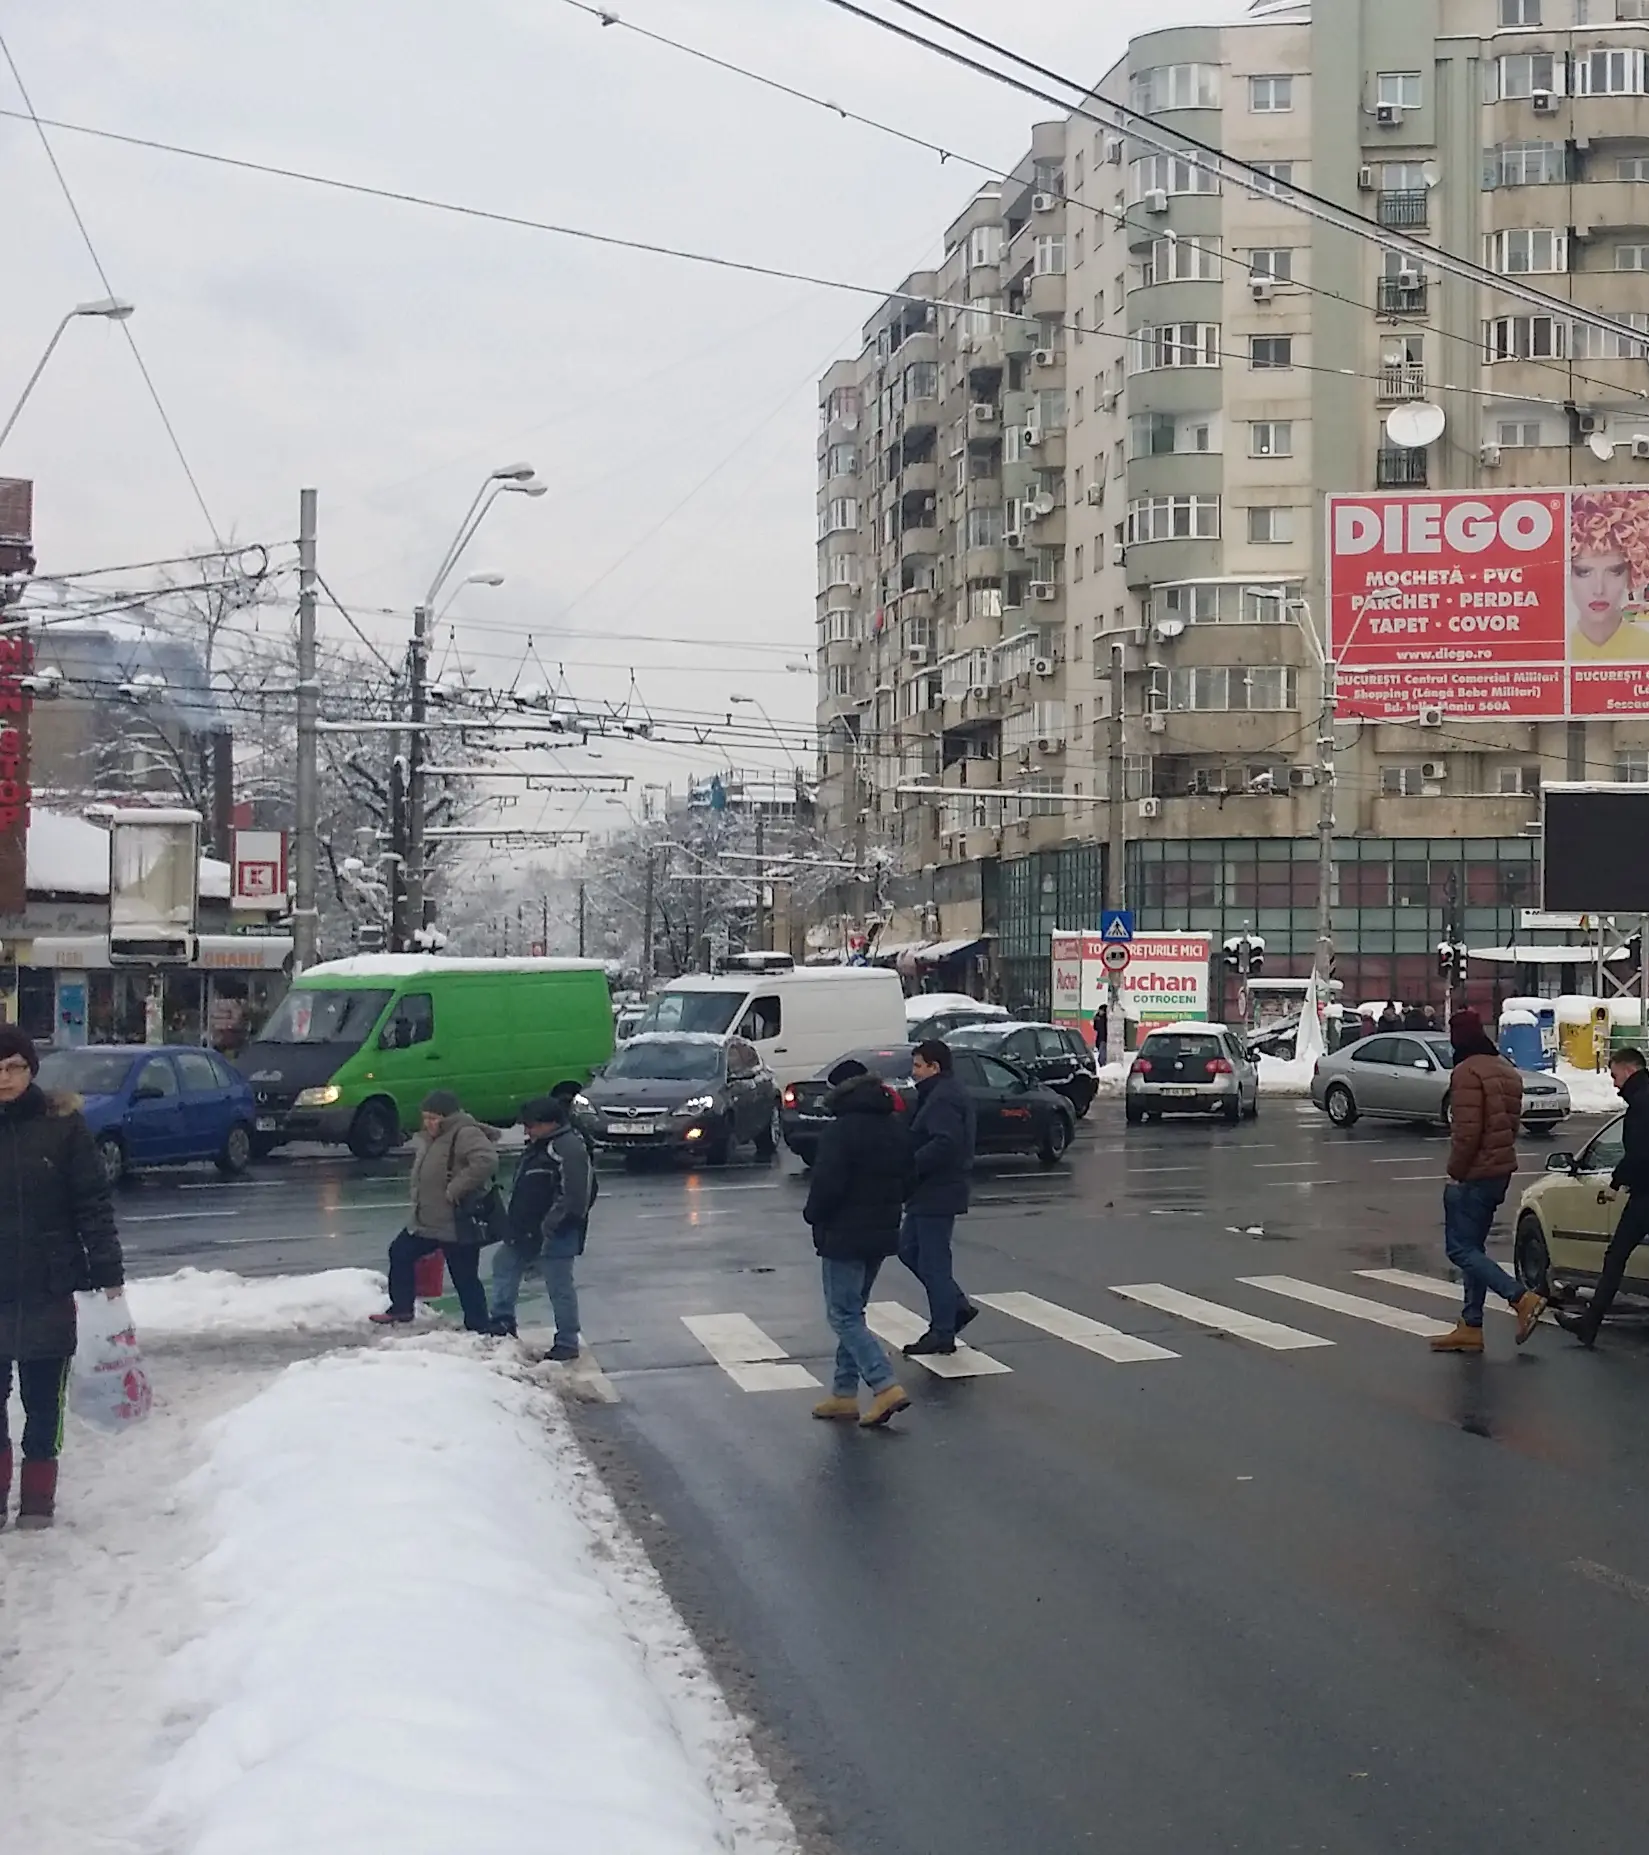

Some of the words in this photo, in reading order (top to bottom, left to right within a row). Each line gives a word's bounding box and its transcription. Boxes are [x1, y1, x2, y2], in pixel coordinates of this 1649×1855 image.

[1335, 500, 1553, 555] DIEGO
[1366, 565, 1464, 587] MOCHETĂ
[1483, 567, 1523, 584] PVC
[1460, 591, 1539, 608] PERDEA
[1369, 617, 1429, 633] TAPET
[1449, 615, 1520, 632] COVOR
[1396, 647, 1493, 661] www.diego.ro
[1180, 945, 1203, 957] MICI
[1133, 994, 1197, 1004] COTROCENI
